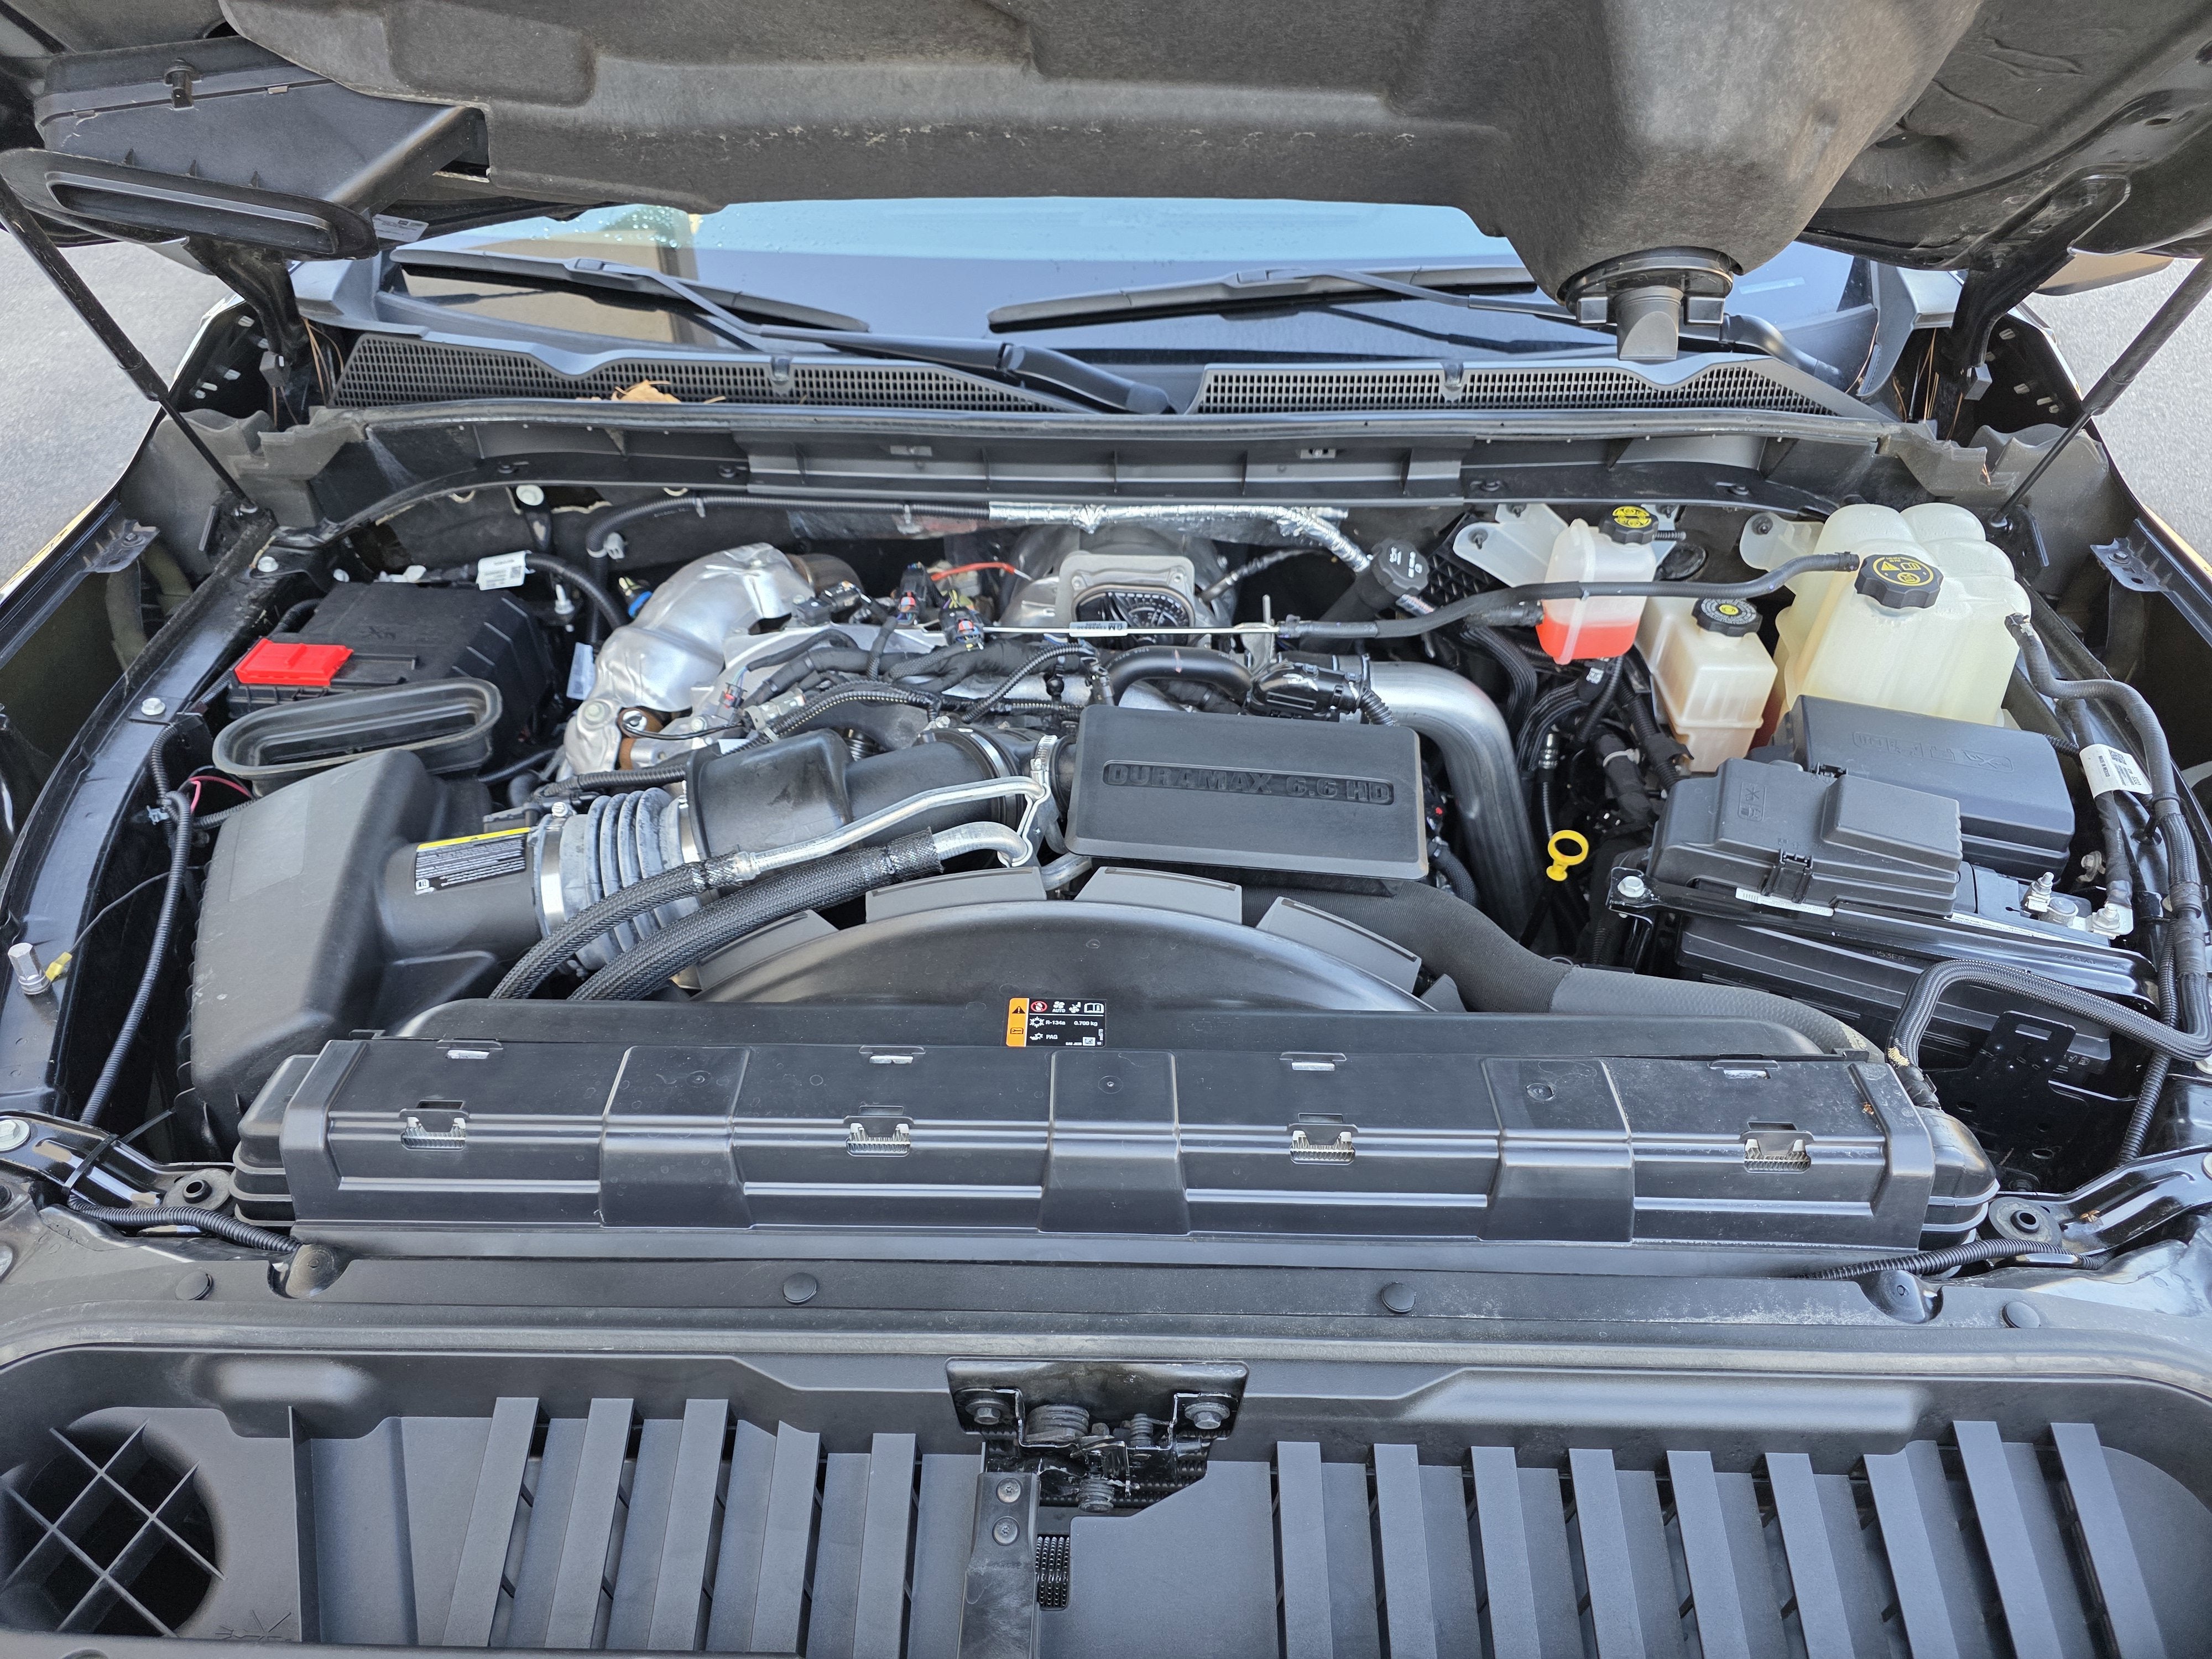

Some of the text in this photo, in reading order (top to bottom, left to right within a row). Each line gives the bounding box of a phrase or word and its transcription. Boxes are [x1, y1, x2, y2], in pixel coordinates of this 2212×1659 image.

[1107, 764, 1390, 804] DURAMAX 6.6 HD
